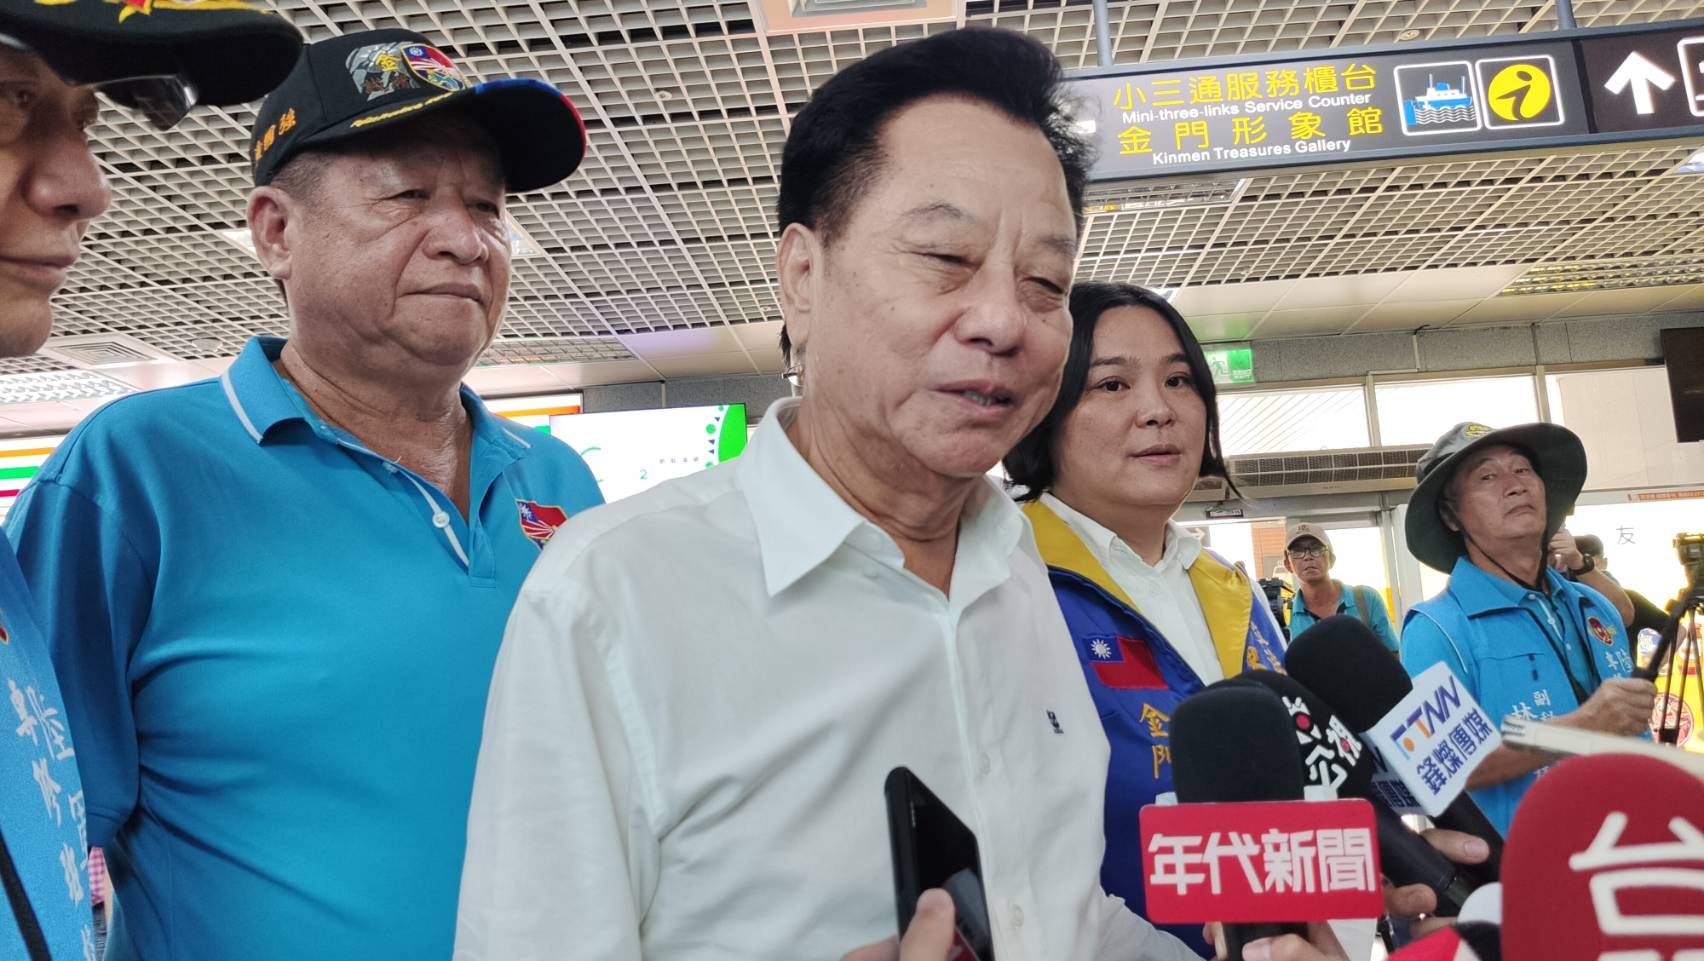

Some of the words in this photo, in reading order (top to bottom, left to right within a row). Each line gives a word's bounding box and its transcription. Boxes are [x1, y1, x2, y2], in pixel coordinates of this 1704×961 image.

[1113, 63, 1377, 111] 小三通服務櫃台
[1122, 104, 1239, 124] Mini-three-links
[1245, 98, 1303, 115] Service
[1308, 93, 1372, 108] Counter
[1153, 151, 1211, 165] Kinmen
[1213, 142, 1292, 160] Treasures
[1295, 138, 1352, 154] Gallery
[1148, 827, 1377, 896] 年代新聞
